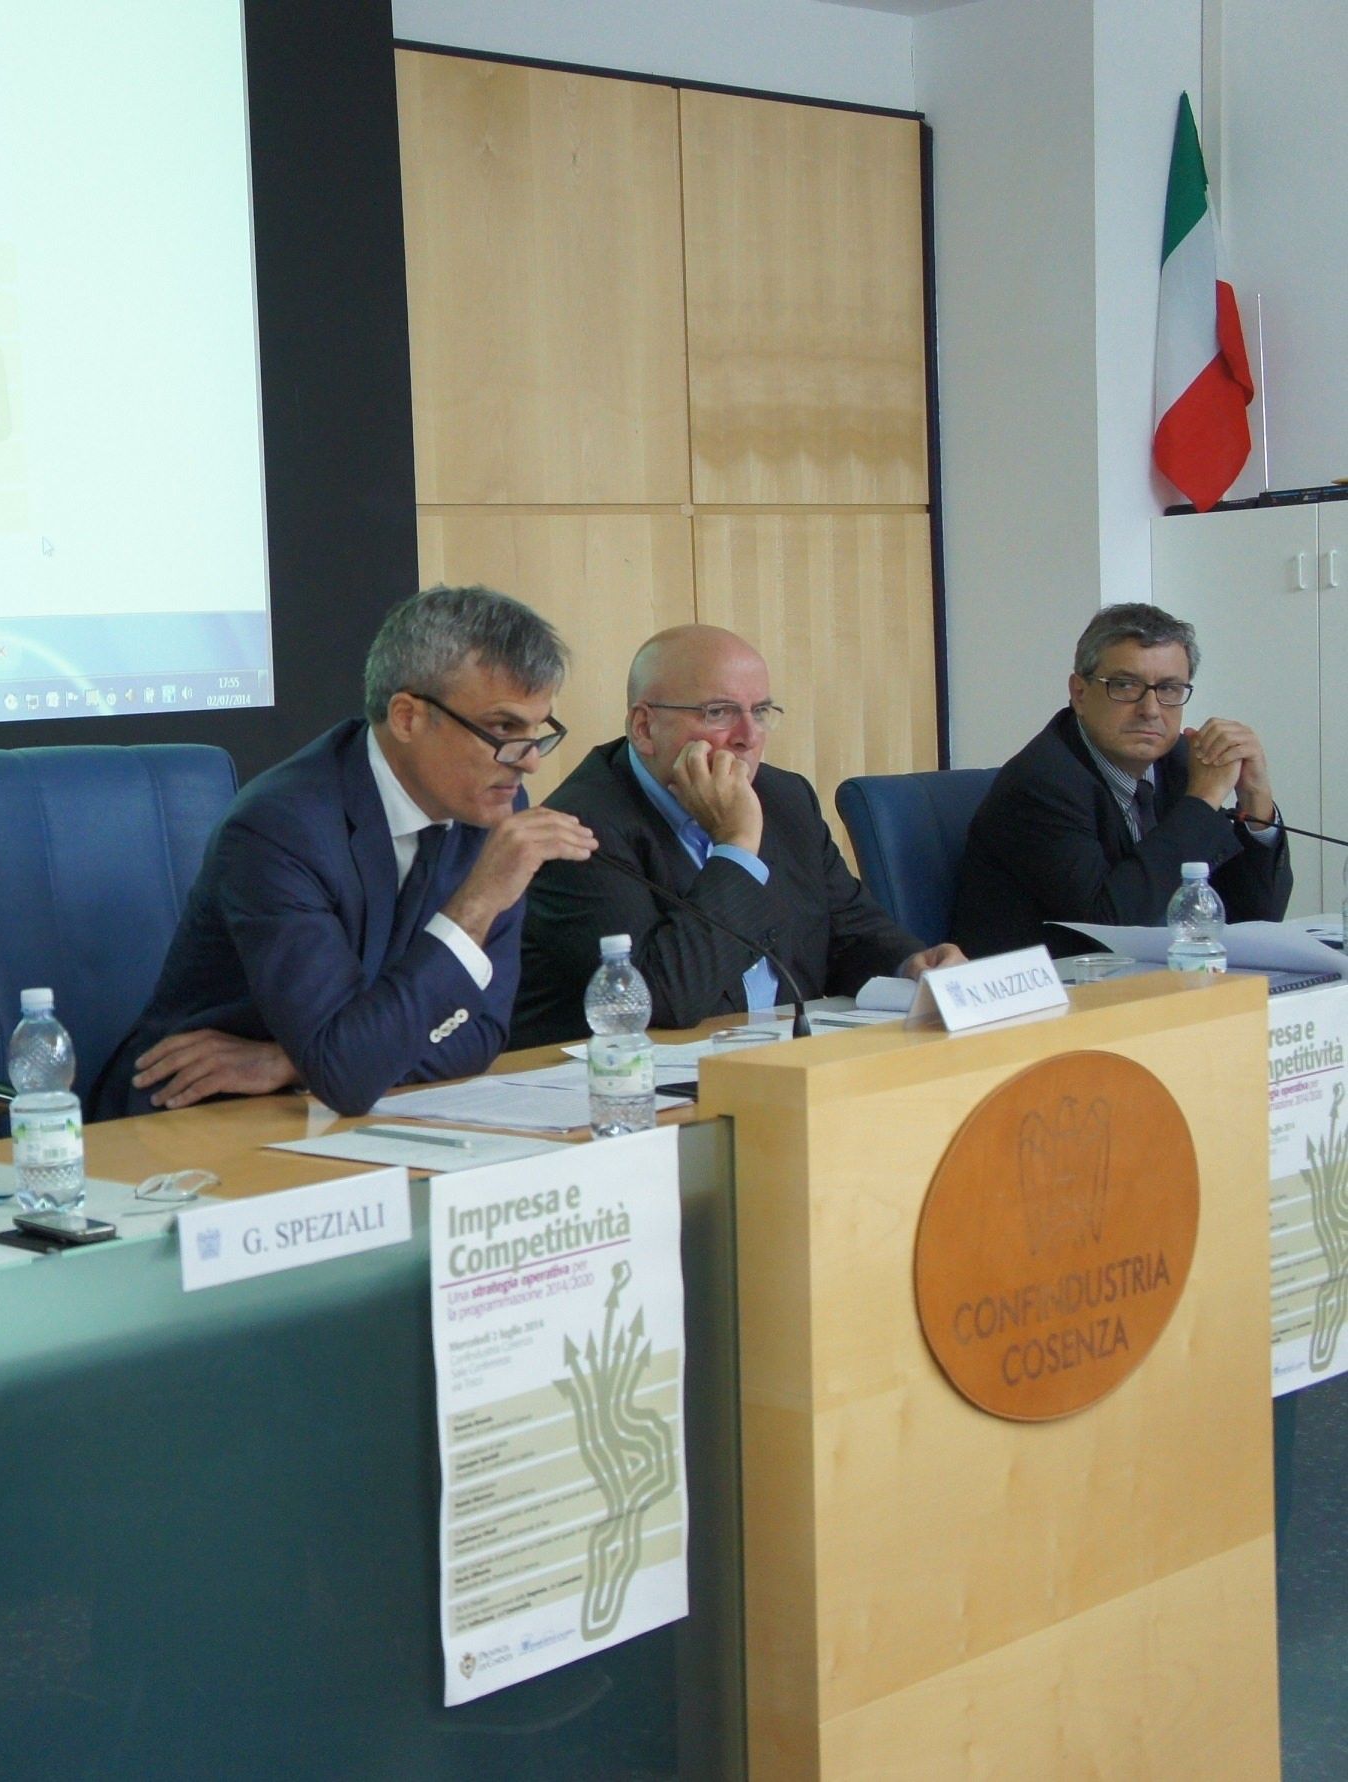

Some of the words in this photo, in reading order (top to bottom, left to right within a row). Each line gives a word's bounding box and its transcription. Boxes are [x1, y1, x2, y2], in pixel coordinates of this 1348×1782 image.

[206, 694, 251, 706] 02/07/2014
[218, 676, 240, 689] 17:55
[966, 984, 985, 1008] N.
[984, 966, 1054, 1003] MAZZUCA
[1305, 1020, 1315, 1040] e
[242, 1227, 269, 1256] G.
[275, 1202, 386, 1250] SPEZIALI
[447, 1187, 560, 1241] Impresa
[565, 1184, 581, 1210] e
[447, 1201, 631, 1279] Competitività
[446, 1290, 470, 1306] Una
[471, 1275, 519, 1301] strategia
[521, 1264, 570, 1290] operativa
[571, 1259, 588, 1275] per
[447, 1305, 457, 1322] la
[458, 1287, 543, 1321] programmazione
[545, 1272, 595, 1300] 2014/2020
[953, 1250, 1172, 1347] CONFINDUSTRIA
[1002, 1315, 1130, 1388] COSENZA
